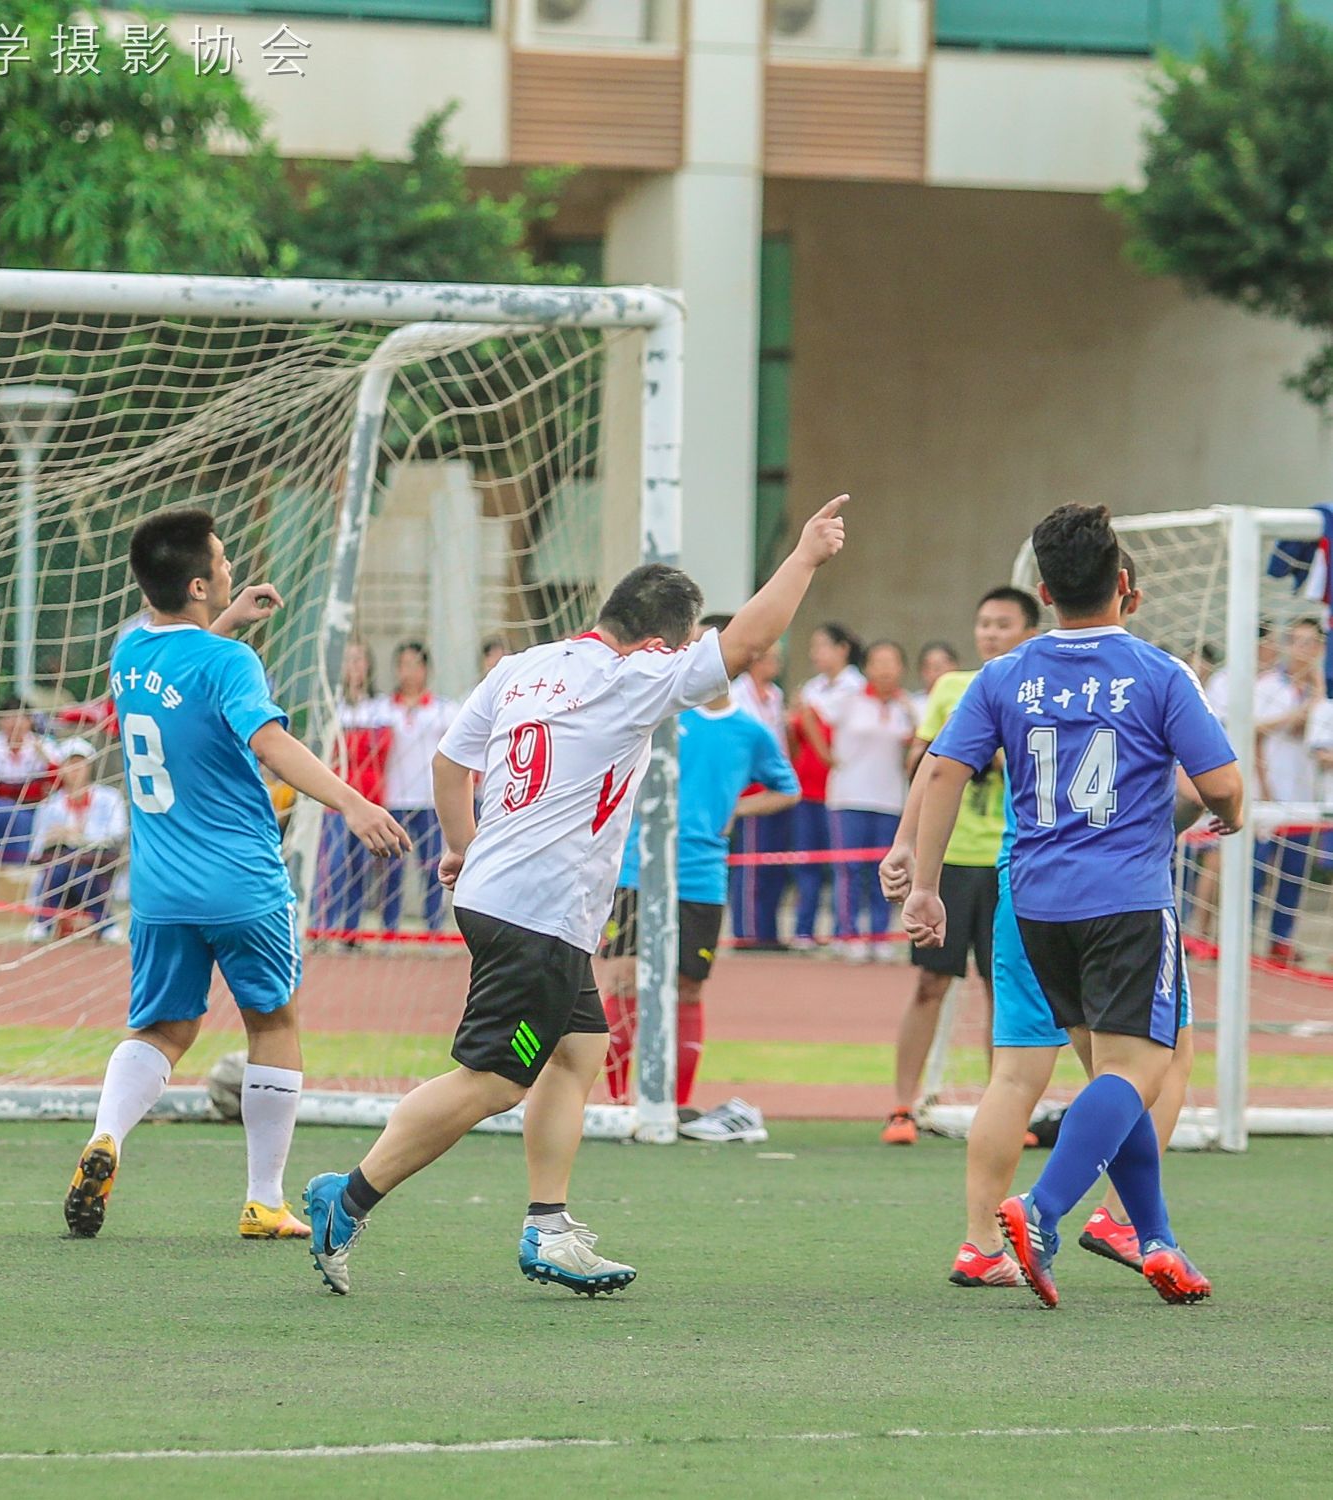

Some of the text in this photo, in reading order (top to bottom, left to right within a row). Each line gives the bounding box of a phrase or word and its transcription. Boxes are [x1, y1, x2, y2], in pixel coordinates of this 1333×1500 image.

[123, 712, 175, 814] 8
[501, 719, 553, 815] 9
[1027, 727, 1118, 829] 14
